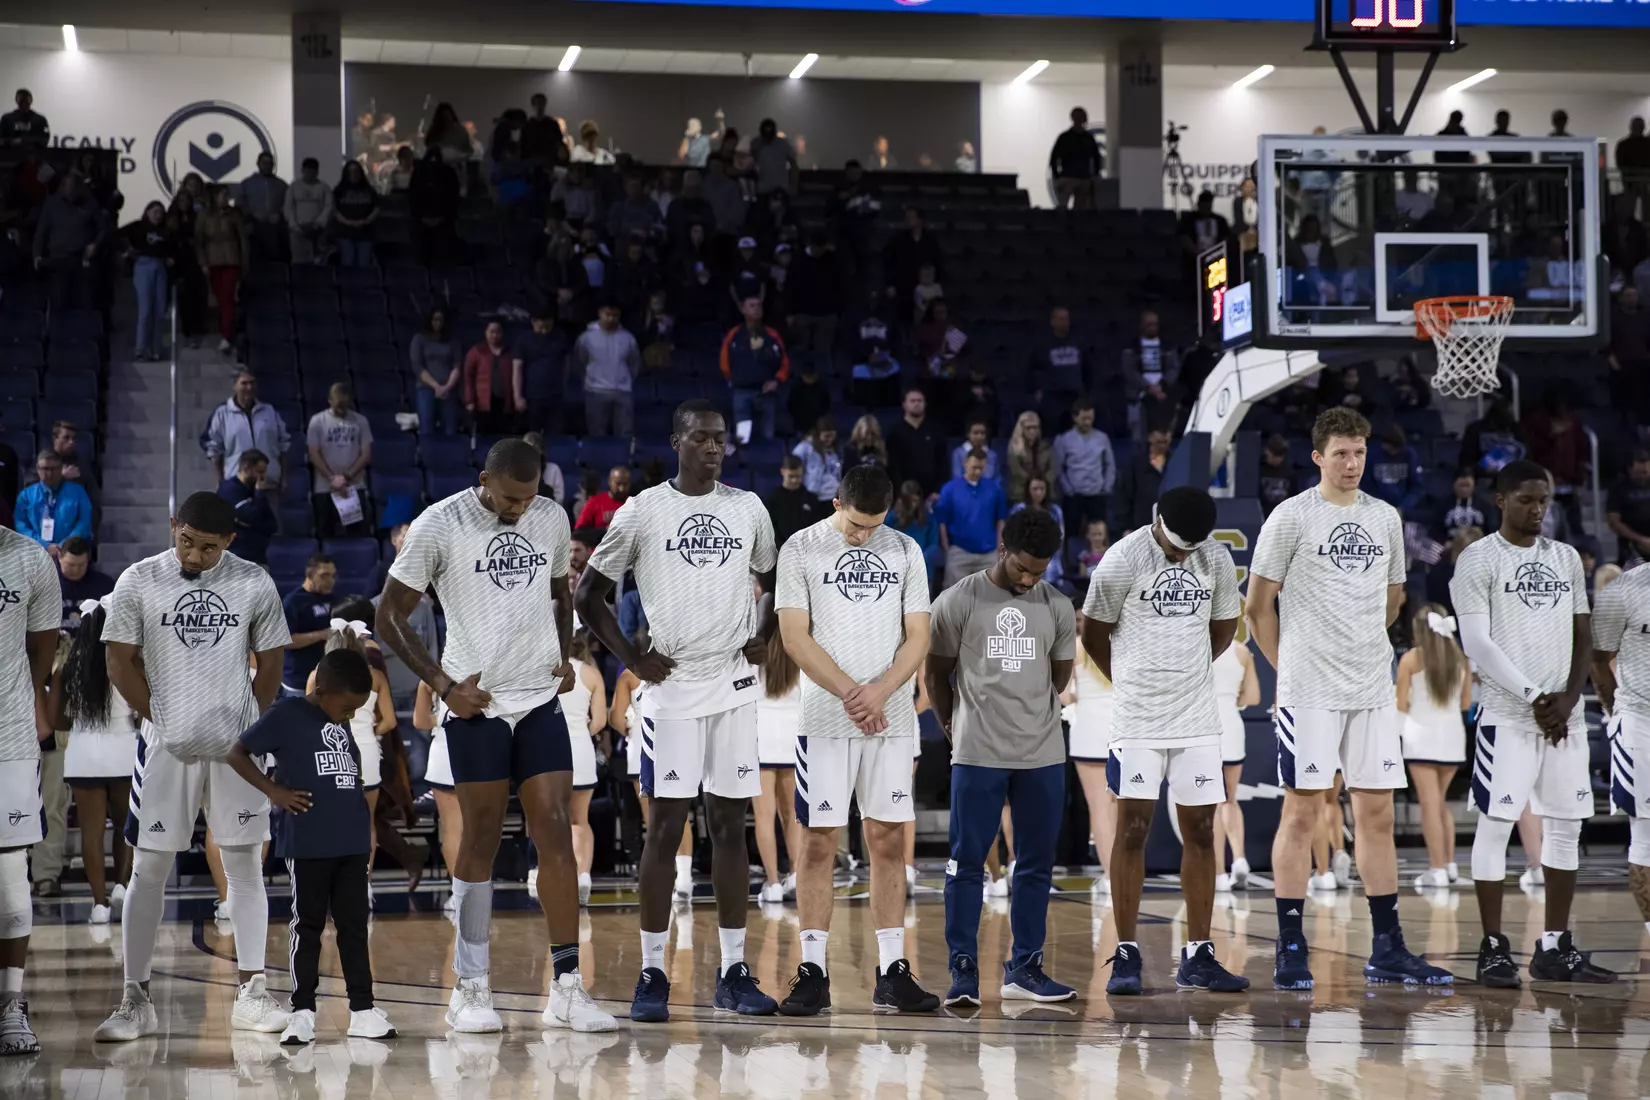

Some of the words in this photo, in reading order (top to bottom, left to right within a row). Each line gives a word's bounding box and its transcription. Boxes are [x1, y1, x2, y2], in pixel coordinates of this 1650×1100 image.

[53, 135, 136, 153] ICALLY
[665, 537, 743, 552] LANCERS
[1318, 544, 1384, 556] LANCERS
[474, 552, 548, 573] LANCERS
[499, 569, 529, 577] BASKETBALL
[823, 571, 899, 585] LANCERS
[1504, 581, 1571, 593] LANCERS
[1140, 589, 1212, 602] LANCERS
[161, 613, 240, 628] LANCERS
[1001, 659, 1022, 670] CBU
[335, 775, 356, 786] CBU
